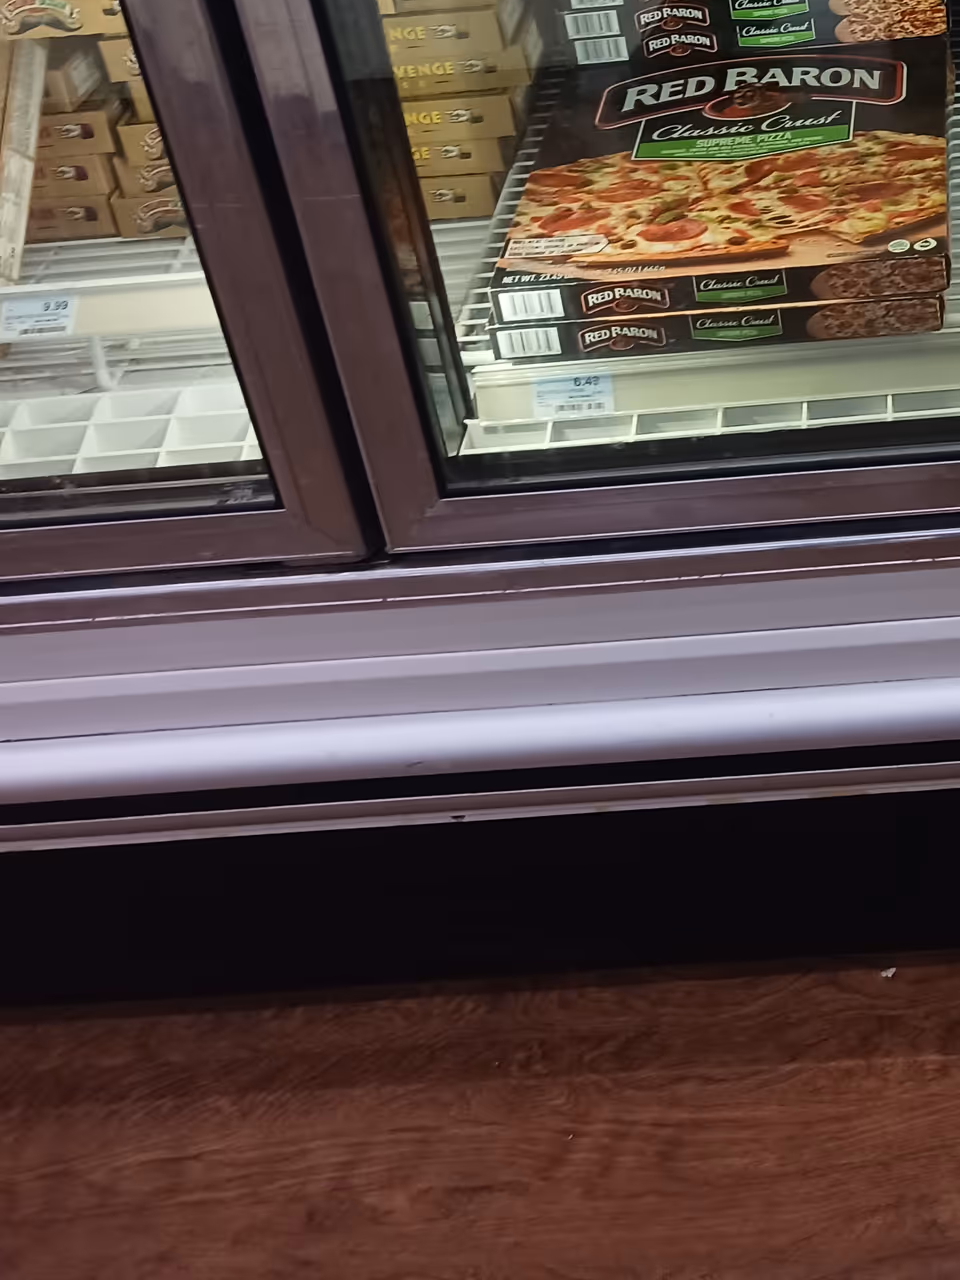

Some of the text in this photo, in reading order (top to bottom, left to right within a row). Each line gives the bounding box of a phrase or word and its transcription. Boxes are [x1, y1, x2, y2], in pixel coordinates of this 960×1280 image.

[742, 20, 809, 36] Classic Crust
[649, 35, 711, 51] RED BARON
[621, 67, 882, 113] RED BARON
[652, 110, 842, 141] Classic Crust
[696, 131, 793, 148] SUPREME PIZZA
[501, 275, 519, 284] NET
[521, 274, 537, 283] WT.
[700, 274, 781, 290] Classic Crust
[587, 287, 661, 306] RED BARON
[43, 300, 69, 312] 9.99
